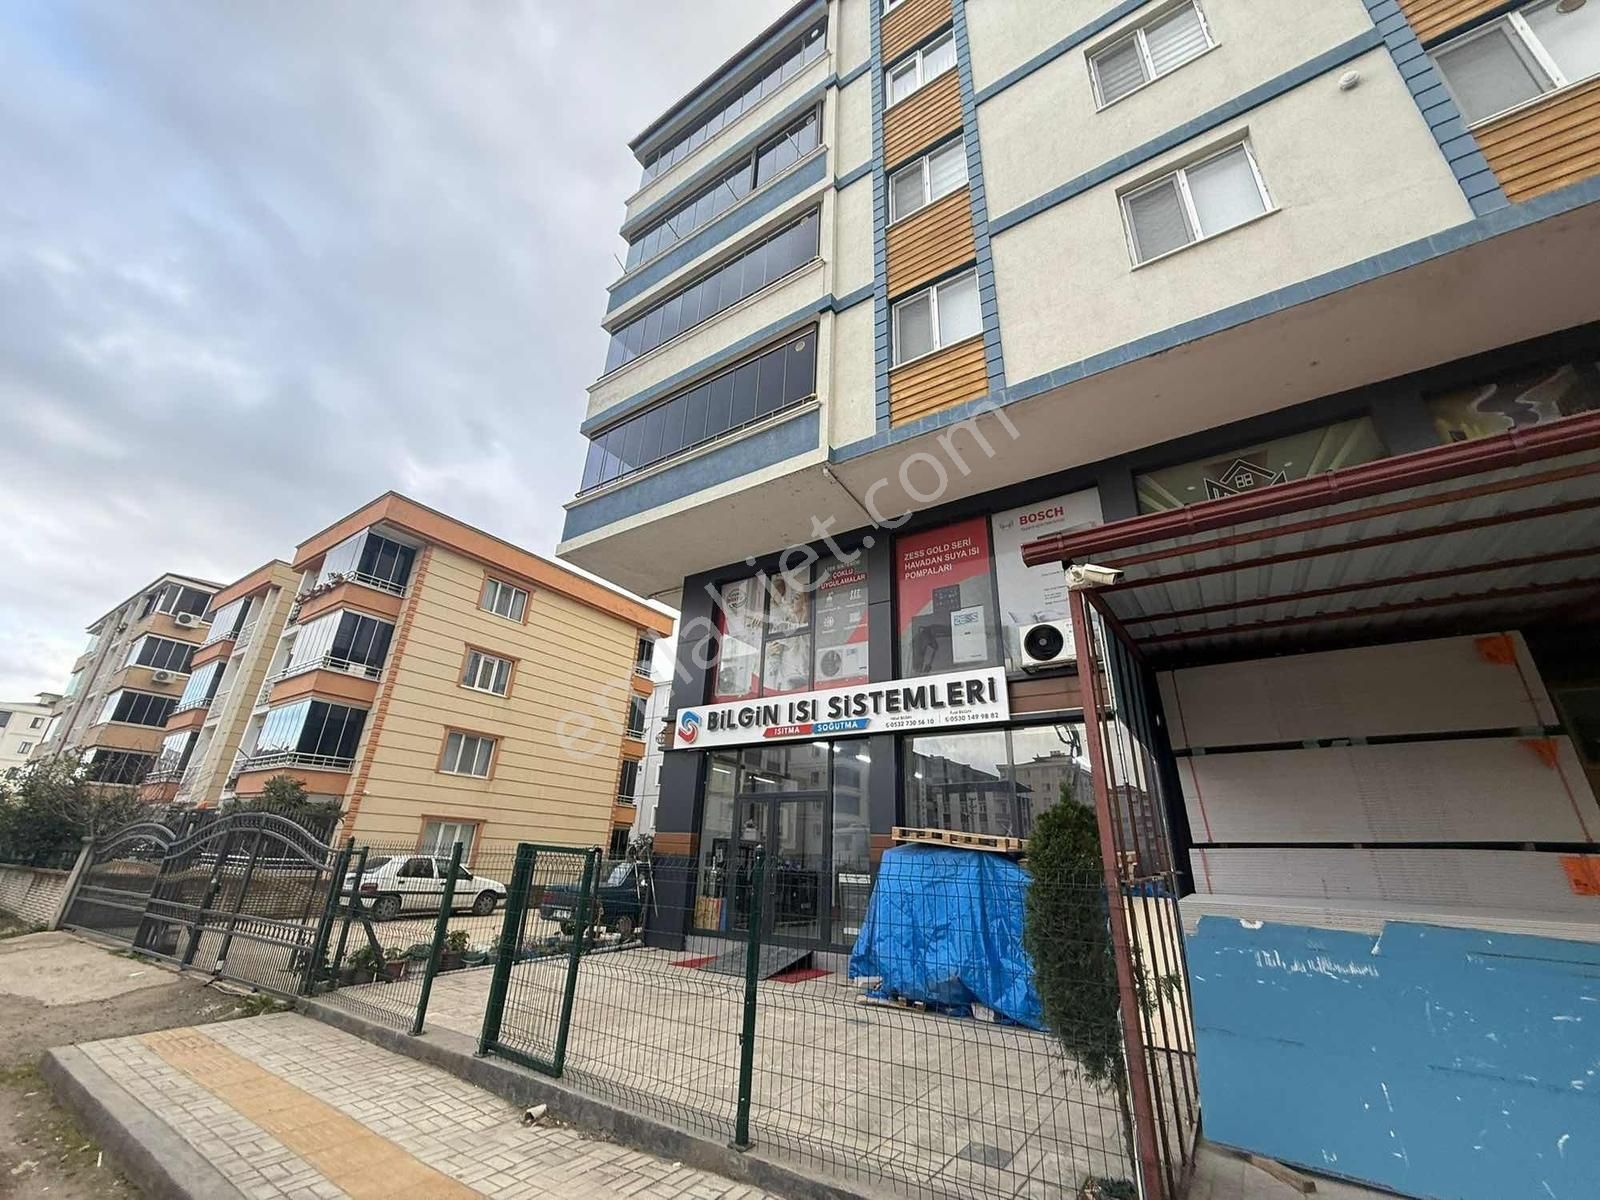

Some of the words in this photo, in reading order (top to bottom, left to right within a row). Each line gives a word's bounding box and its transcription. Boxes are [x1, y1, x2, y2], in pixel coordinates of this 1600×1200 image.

[1019, 506, 1064, 525] BOSCH
[904, 549, 926, 561] ZESS
[926, 543, 950, 555] GOLD
[904, 555, 943, 571] HAVADAN
[944, 550, 968, 562] SUYA
[968, 547, 980, 557] ISI
[904, 563, 953, 580] POMPALARI
[788, 699, 817, 724] ISI
[773, 725, 800, 736] ISITMA
[817, 719, 859, 732] SOĞUTMA
